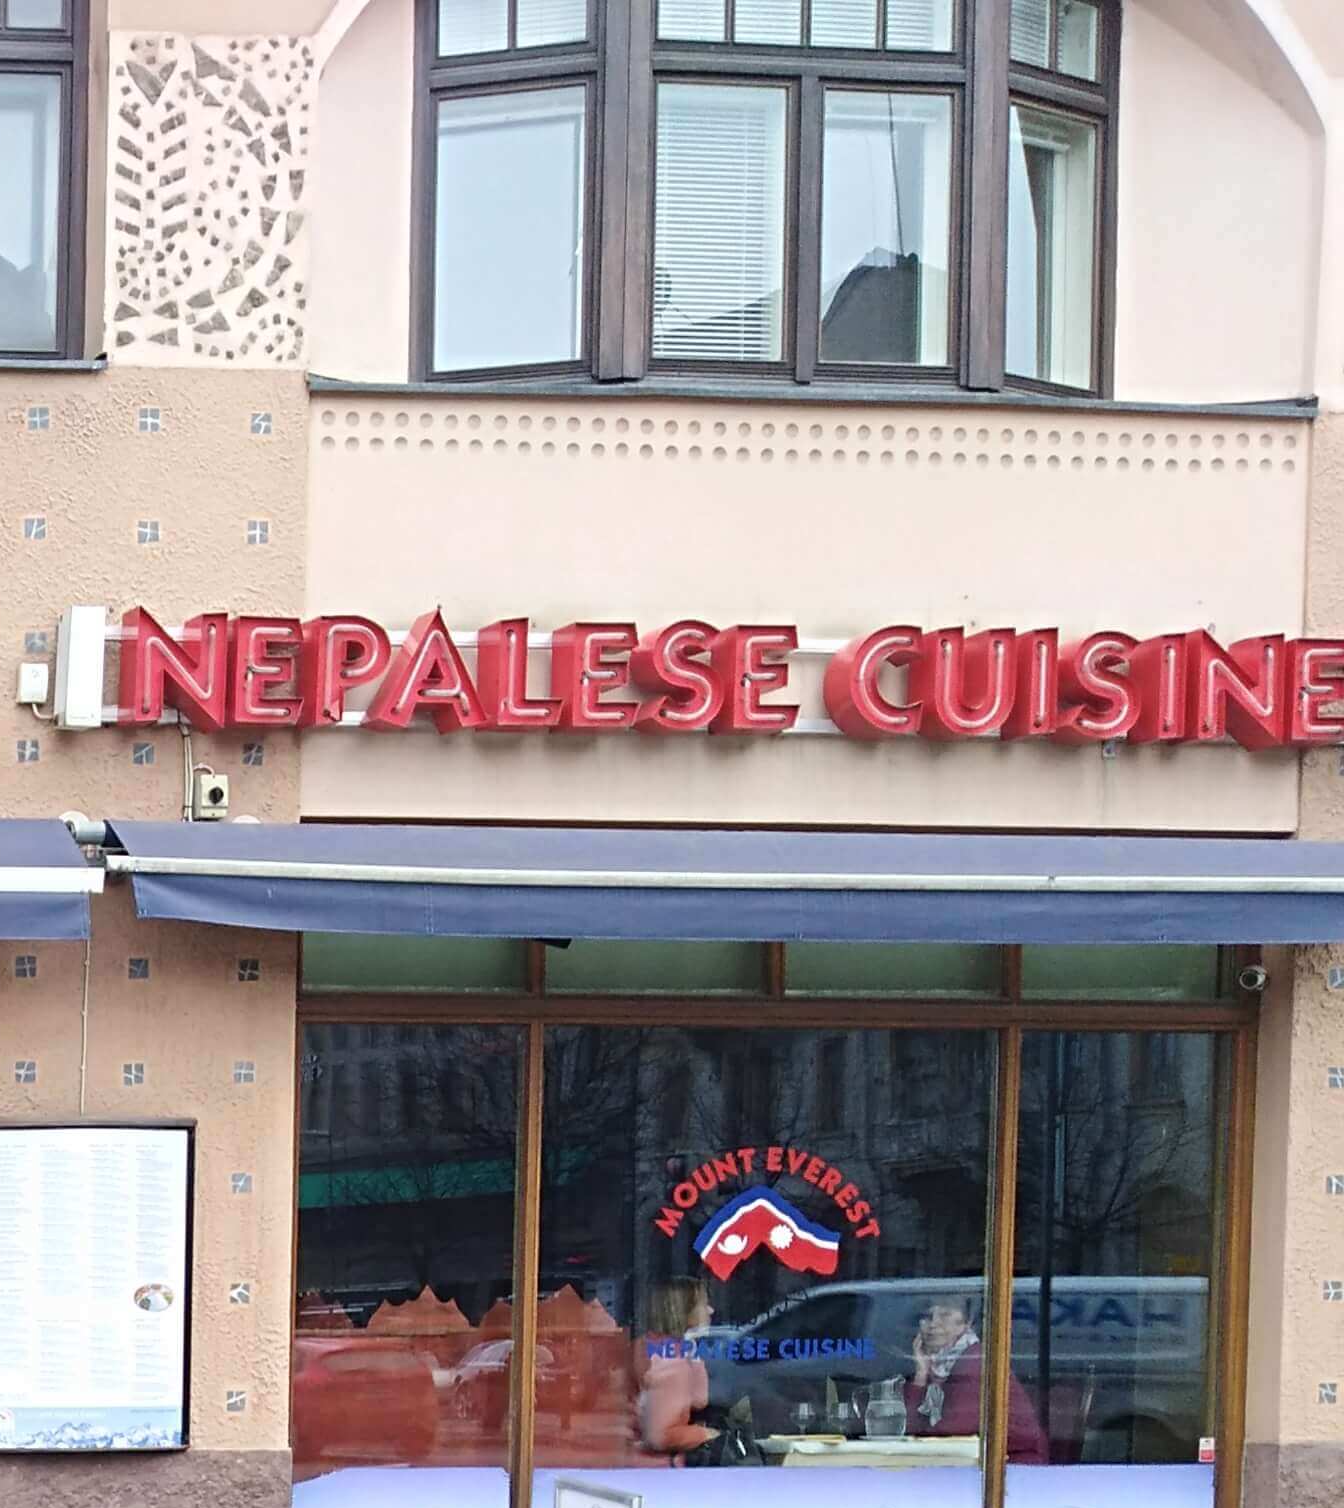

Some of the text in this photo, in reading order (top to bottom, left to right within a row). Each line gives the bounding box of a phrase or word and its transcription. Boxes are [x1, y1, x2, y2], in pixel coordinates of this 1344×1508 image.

[117, 605, 1344, 752] NEPALESE CUISINE
[655, 1146, 881, 1239] MOUNT EVEREST
[646, 1336, 875, 1361] NEPALESE CUISINE
